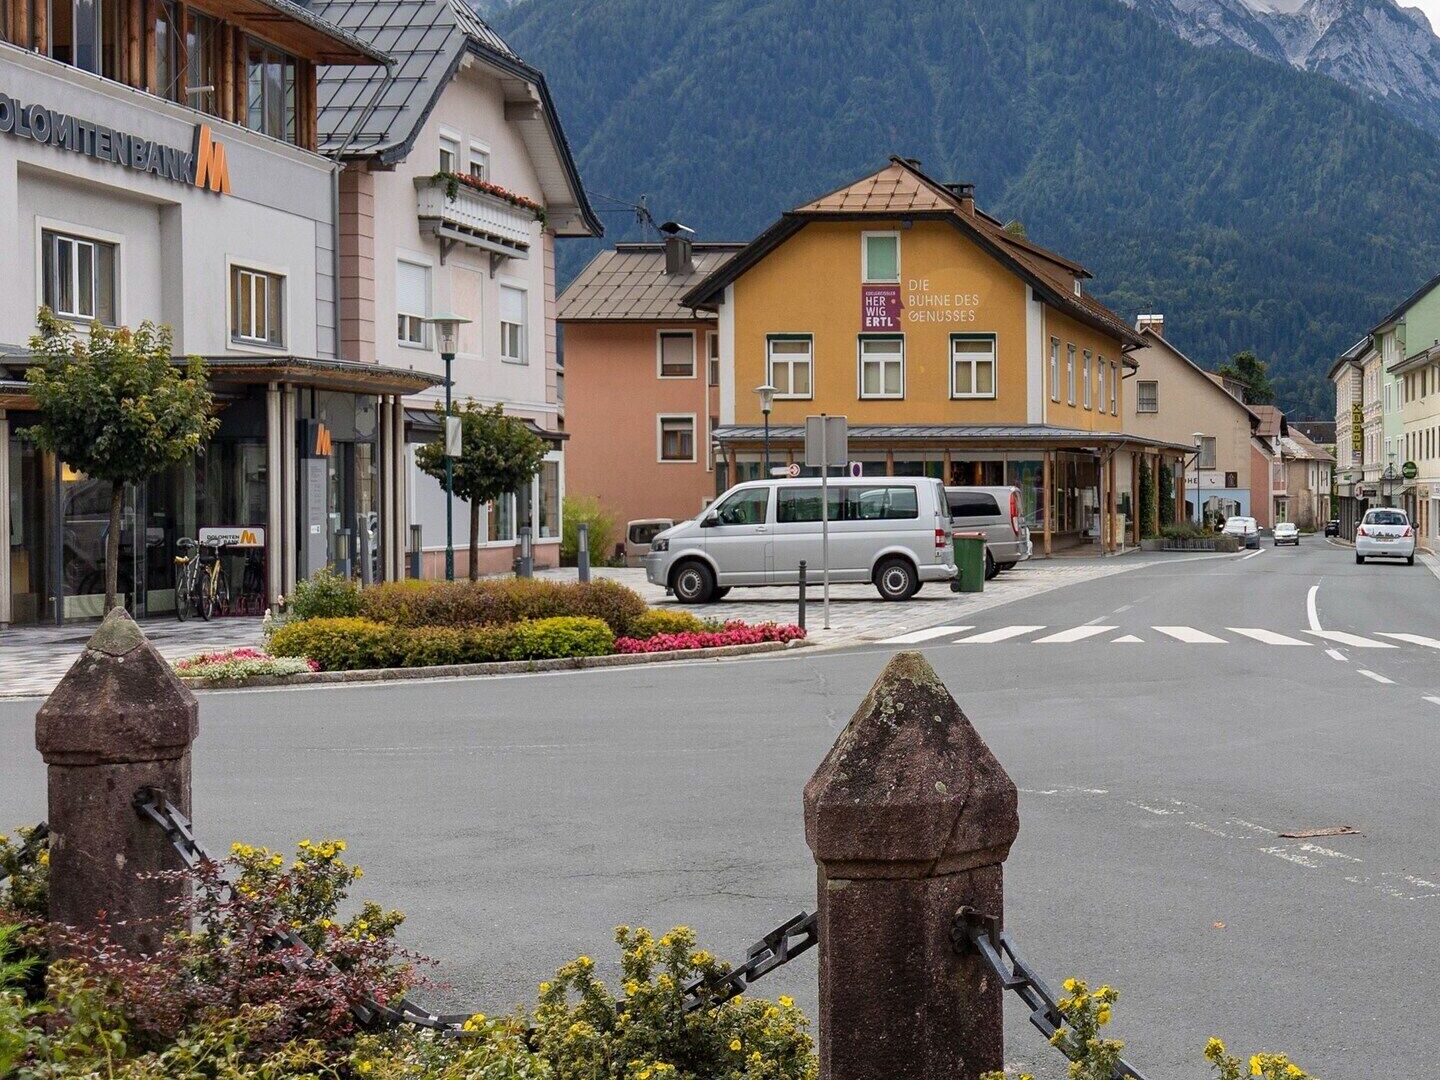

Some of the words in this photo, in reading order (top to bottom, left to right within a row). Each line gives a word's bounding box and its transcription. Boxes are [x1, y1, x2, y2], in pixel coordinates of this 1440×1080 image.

[908, 279, 929, 291] DIE
[865, 296, 886, 307] HER
[954, 294, 979, 306] DES
[866, 307, 886, 317] WIG
[908, 309, 976, 323] GENUSSES
[866, 317, 894, 327] ERTL
